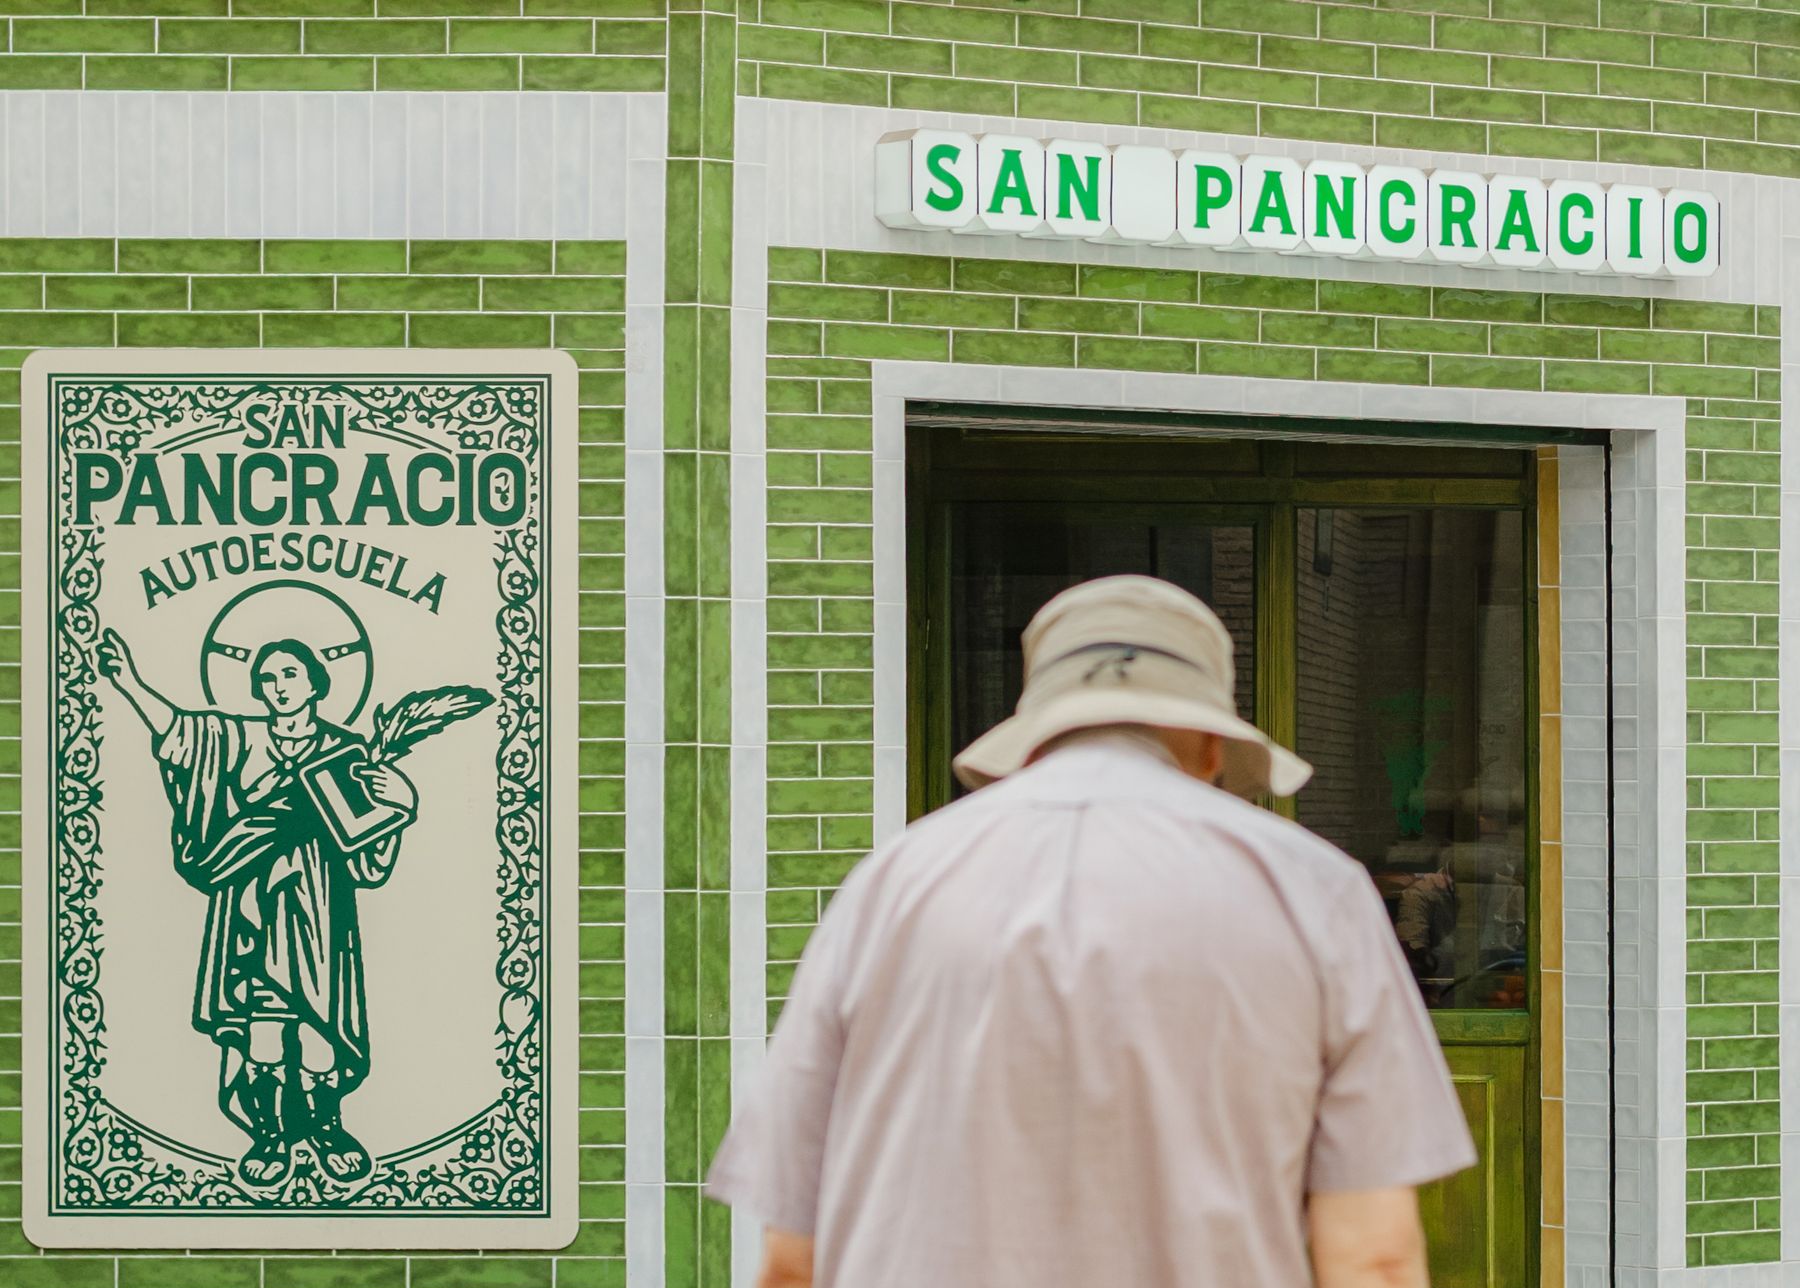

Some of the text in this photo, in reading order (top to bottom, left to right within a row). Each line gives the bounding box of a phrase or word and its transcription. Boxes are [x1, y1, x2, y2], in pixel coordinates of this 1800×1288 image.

[926, 143, 1708, 264] SAN PANCRACIO
[242, 403, 346, 449] SAN
[72, 452, 527, 527] PANCRACIO
[139, 532, 447, 615] AUTOESCUELA
[314, 769, 396, 839] L
